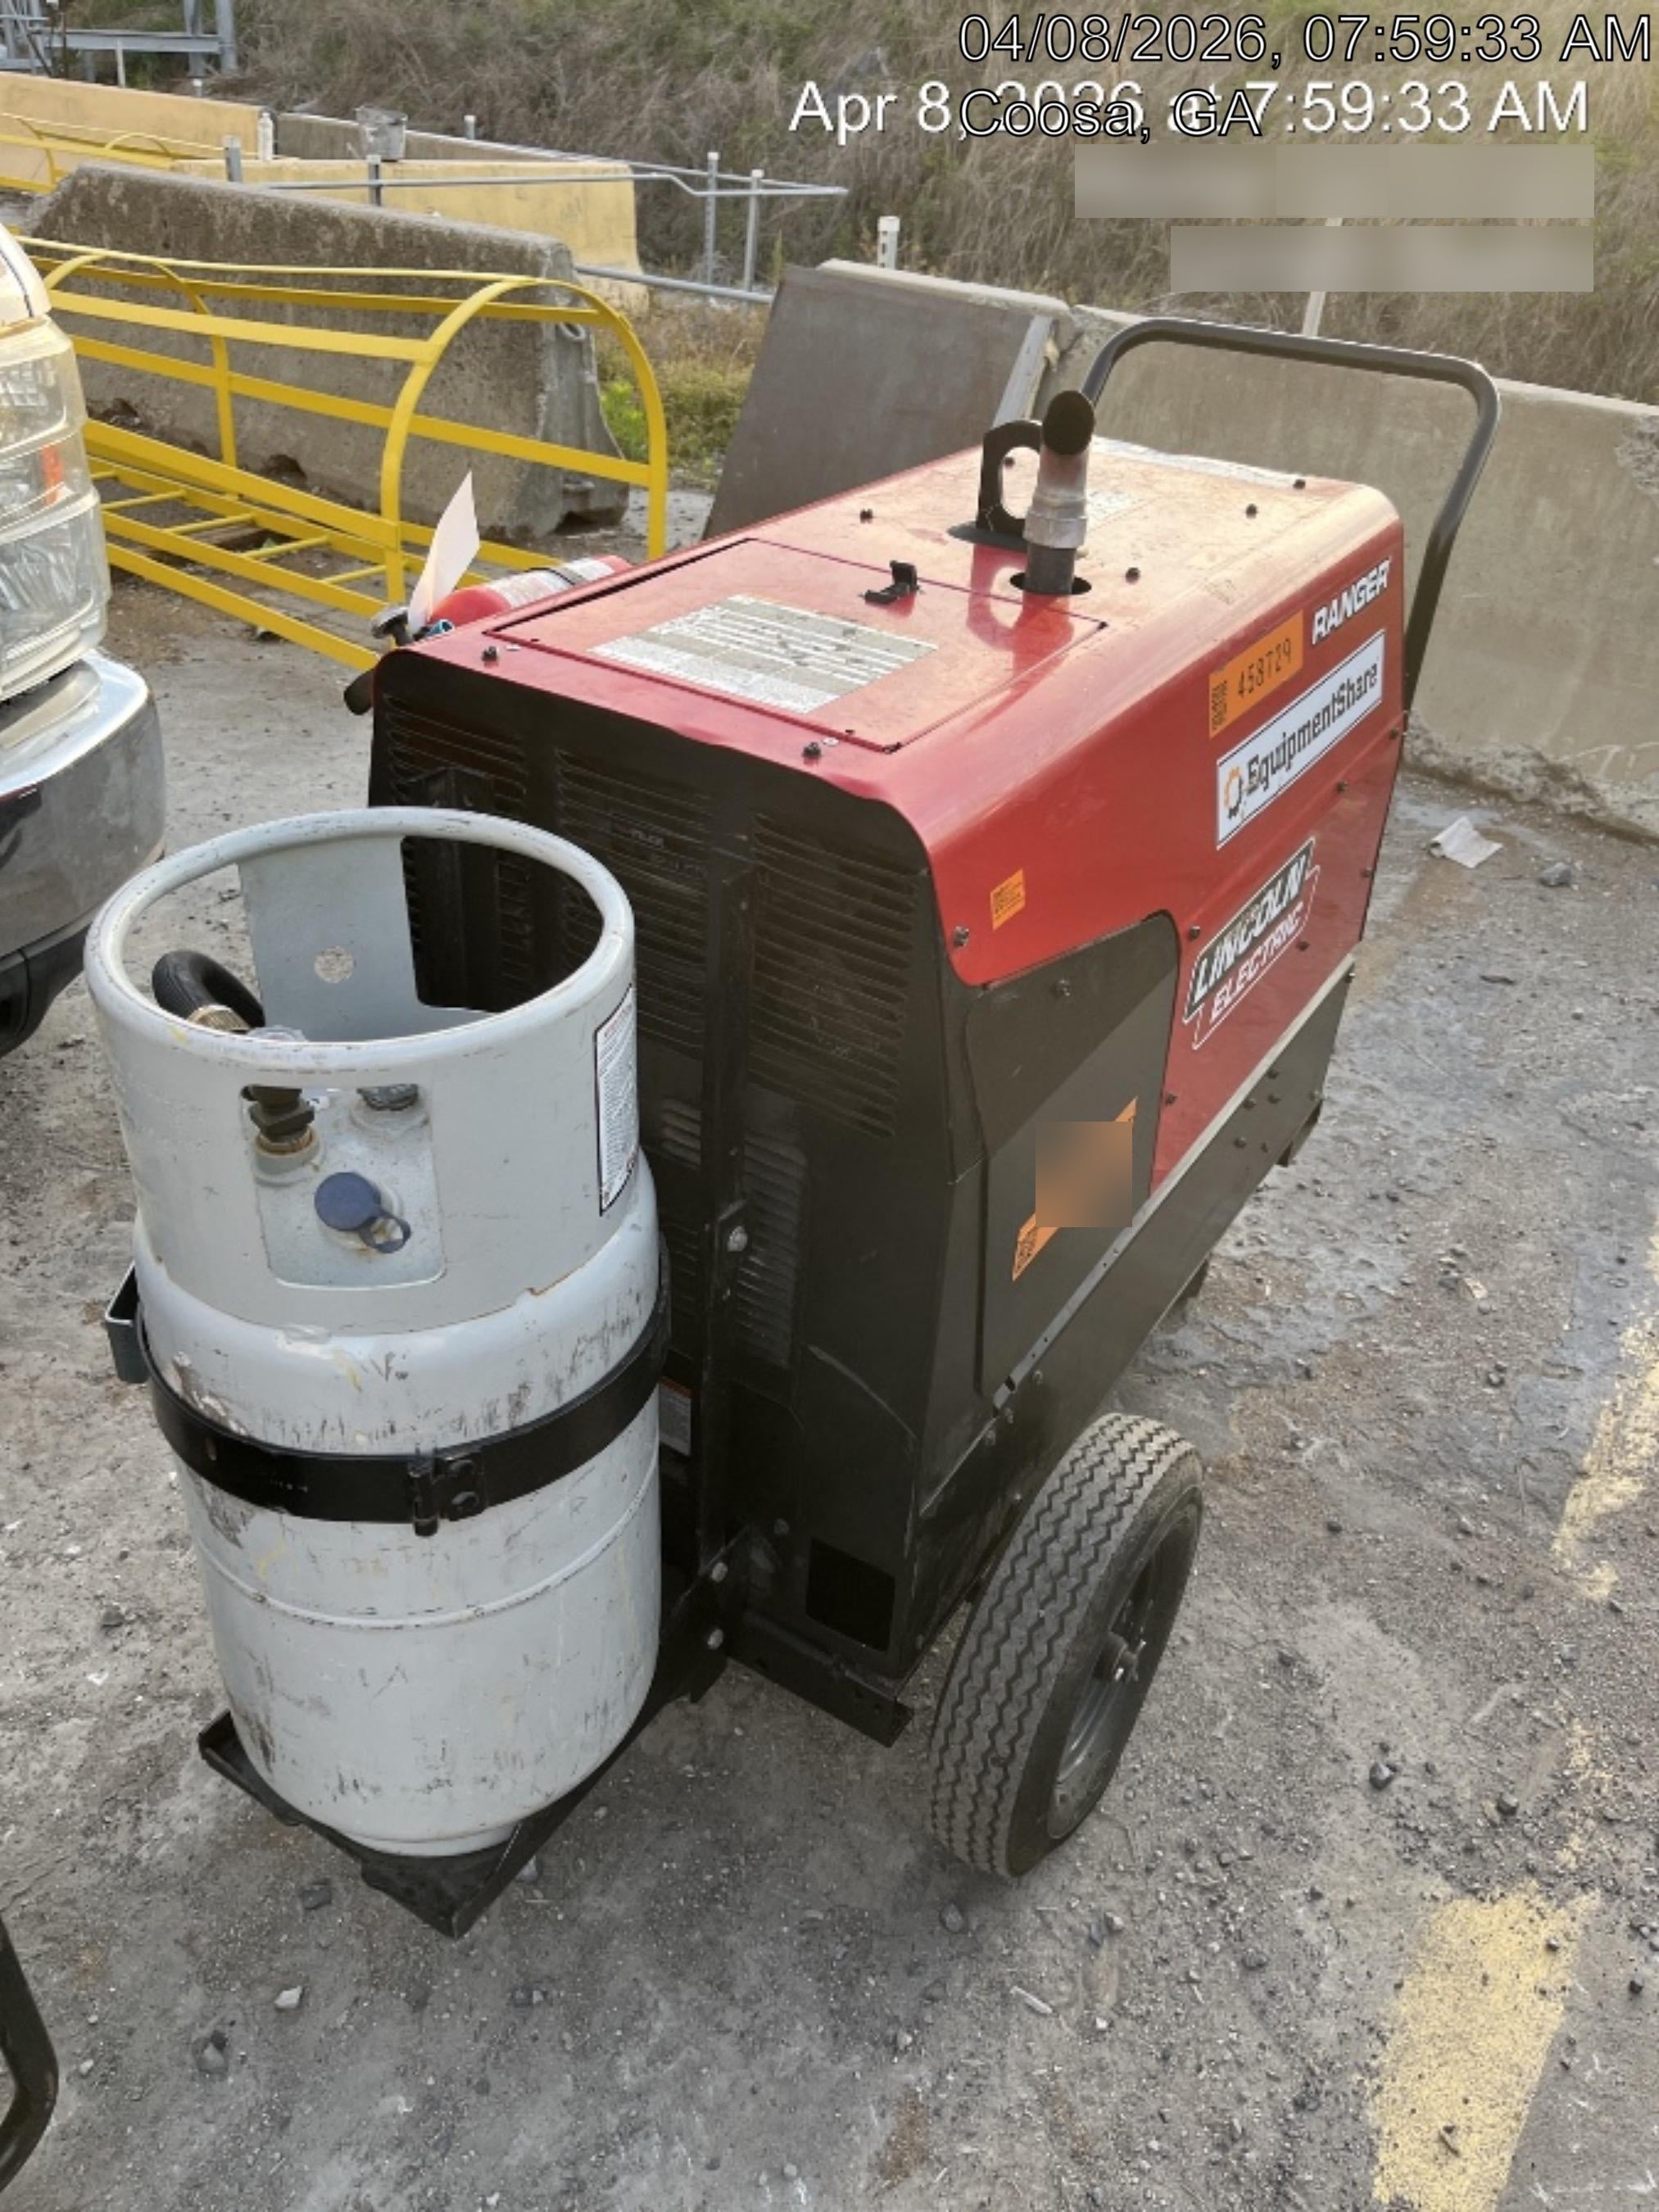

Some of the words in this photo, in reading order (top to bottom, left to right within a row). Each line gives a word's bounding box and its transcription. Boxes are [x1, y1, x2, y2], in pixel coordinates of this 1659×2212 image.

[1312, 559, 1391, 646] RANGER
[1244, 662, 1379, 796] EquipmentShare
[1192, 854, 1307, 1005] LINCOLN
[1209, 901, 1304, 1025] ELECTRIC
